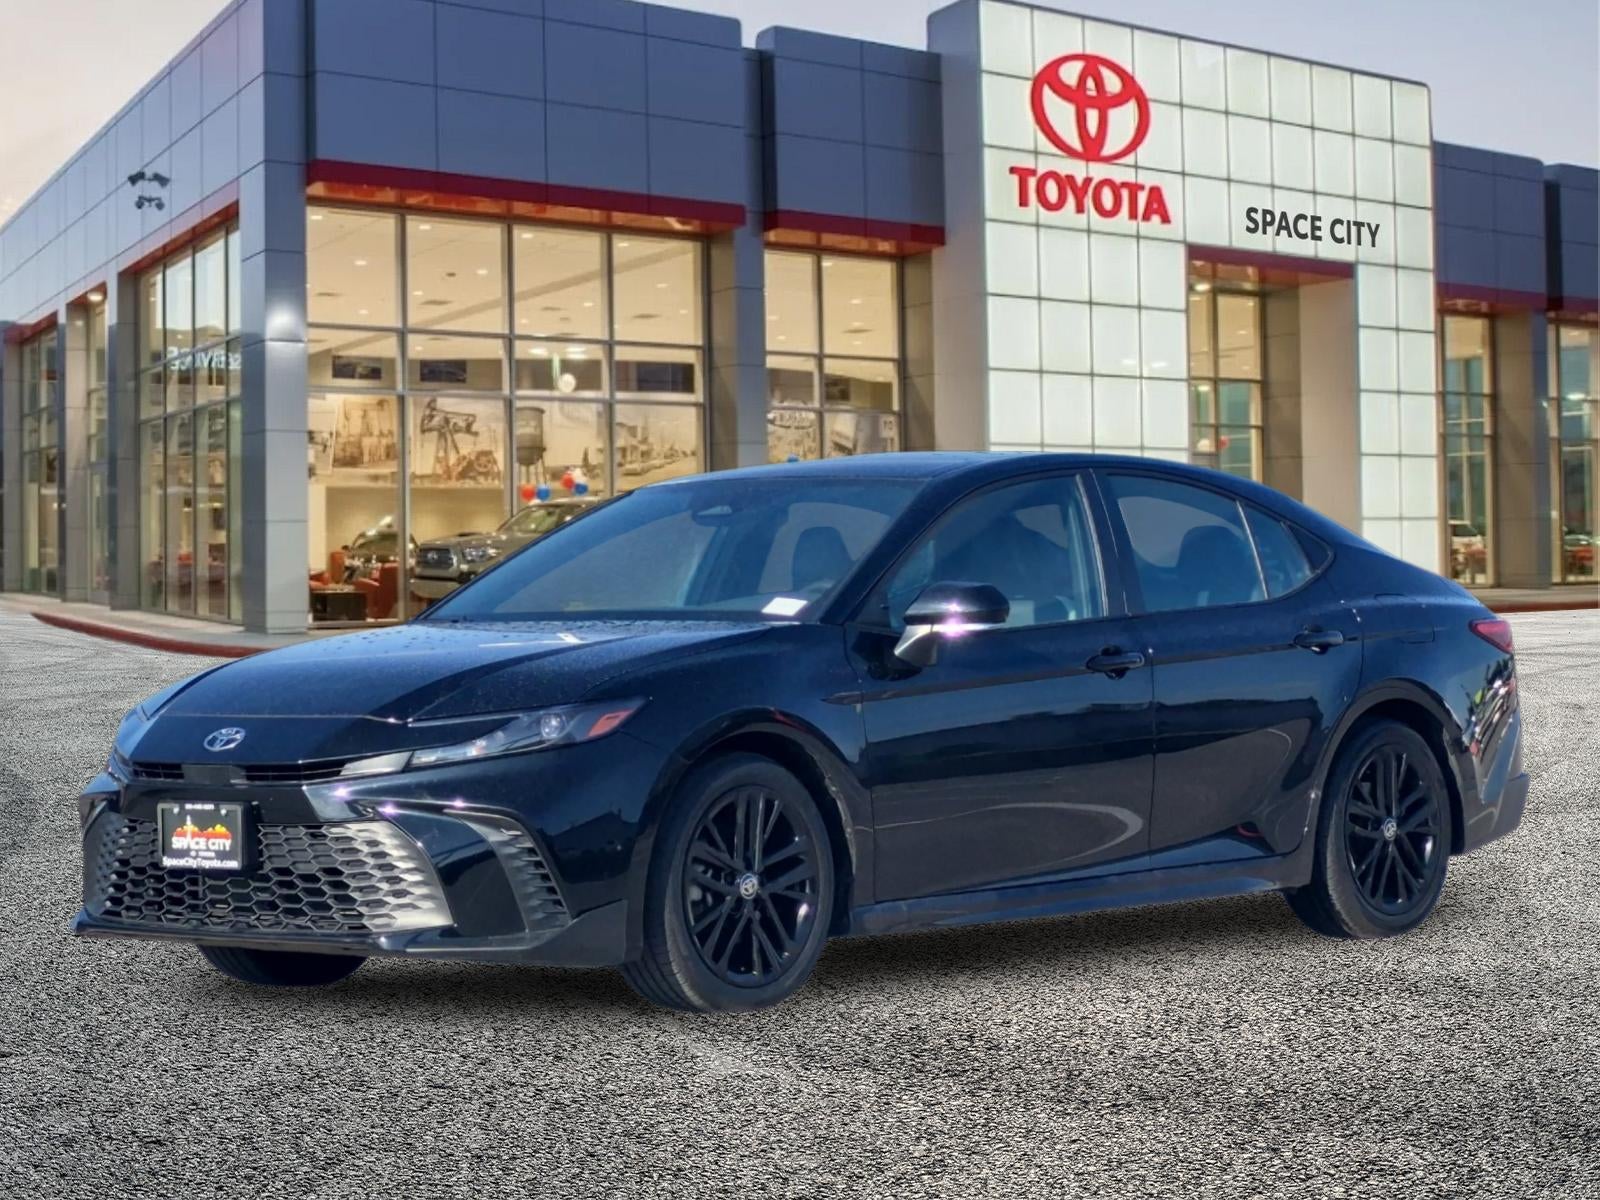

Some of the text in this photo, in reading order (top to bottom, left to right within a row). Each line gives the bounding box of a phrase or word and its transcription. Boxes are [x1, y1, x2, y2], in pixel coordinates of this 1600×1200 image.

[1009, 166, 1171, 225] TOYOTA
[1245, 207, 1381, 248] SPACE CITY
[172, 837, 231, 851] SPACE CITY
